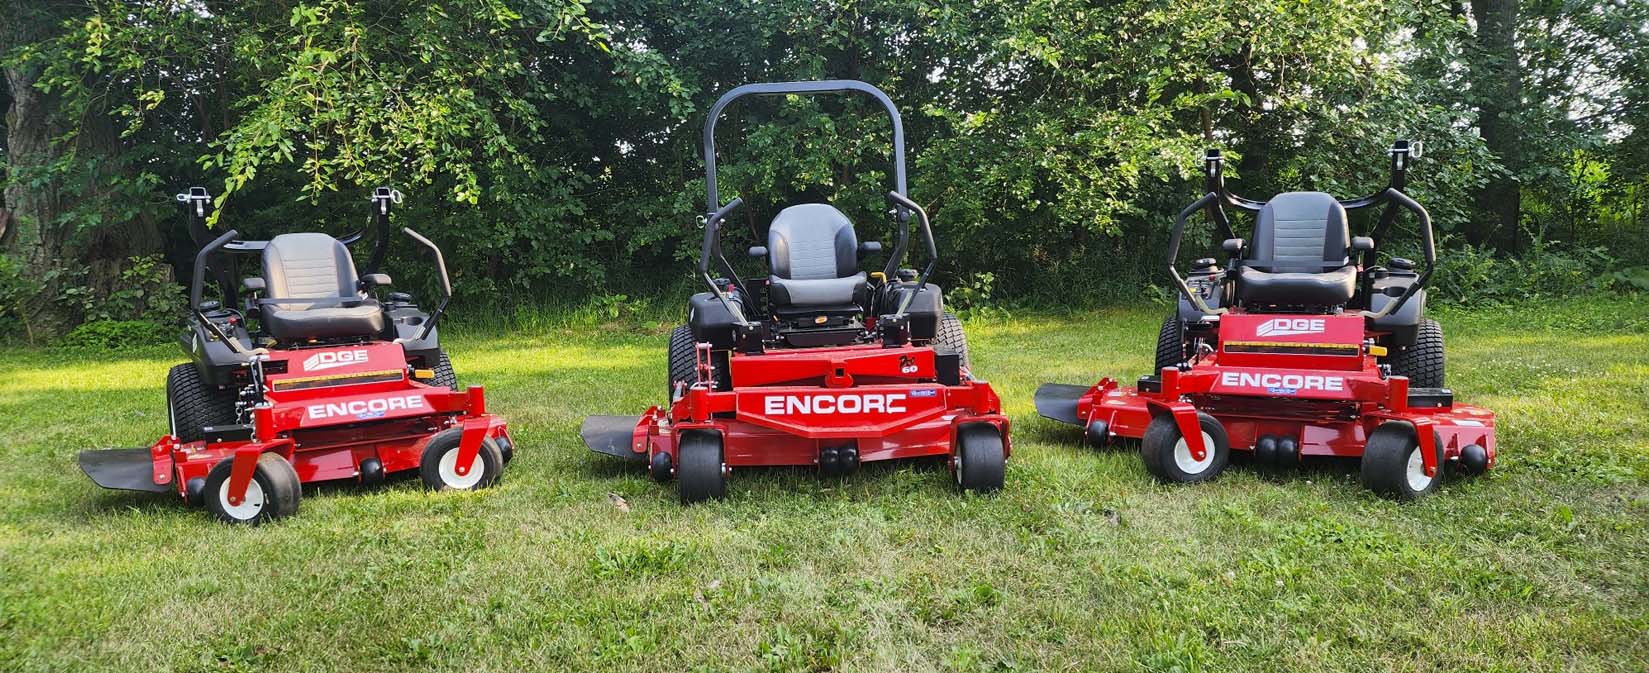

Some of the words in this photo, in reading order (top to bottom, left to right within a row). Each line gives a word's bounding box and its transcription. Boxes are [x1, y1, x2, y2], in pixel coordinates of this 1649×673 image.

[901, 365, 919, 374] 60
[1221, 372, 1344, 391] ENCORE
[307, 395, 424, 420] ENCORE
